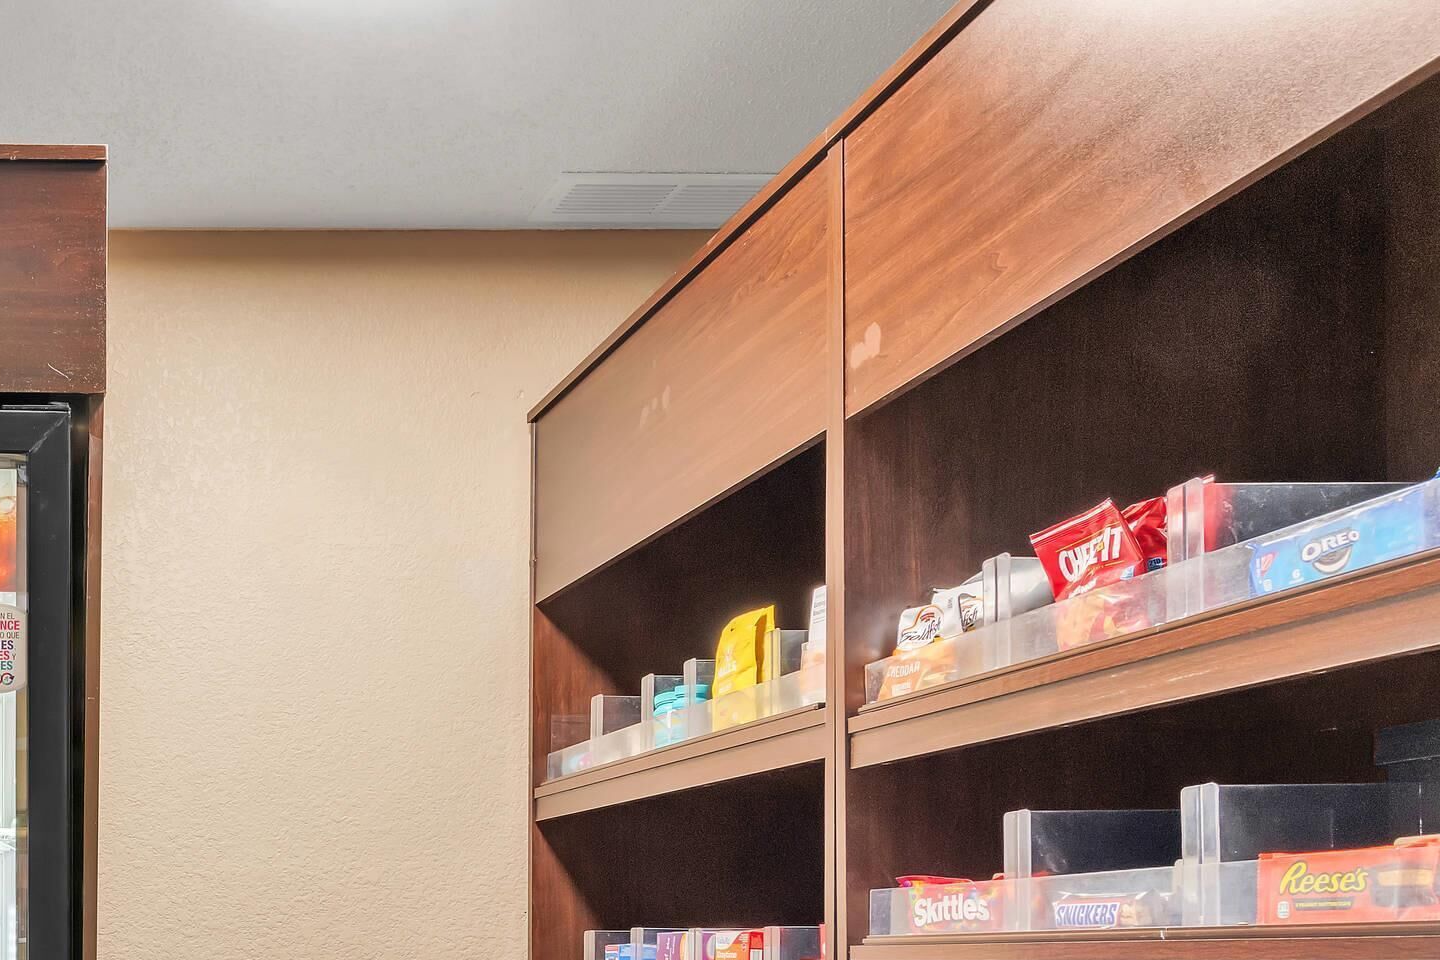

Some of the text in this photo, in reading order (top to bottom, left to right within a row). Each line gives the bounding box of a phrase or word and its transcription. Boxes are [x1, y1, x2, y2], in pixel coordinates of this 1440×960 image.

[1301, 530, 1360, 562] OREO
[6, 612, 15, 620] EL
[6, 631, 20, 639] QUE
[1279, 861, 1369, 895] Reese's
[914, 893, 991, 927] Skittles
[1056, 903, 1117, 926] SNICKERS
